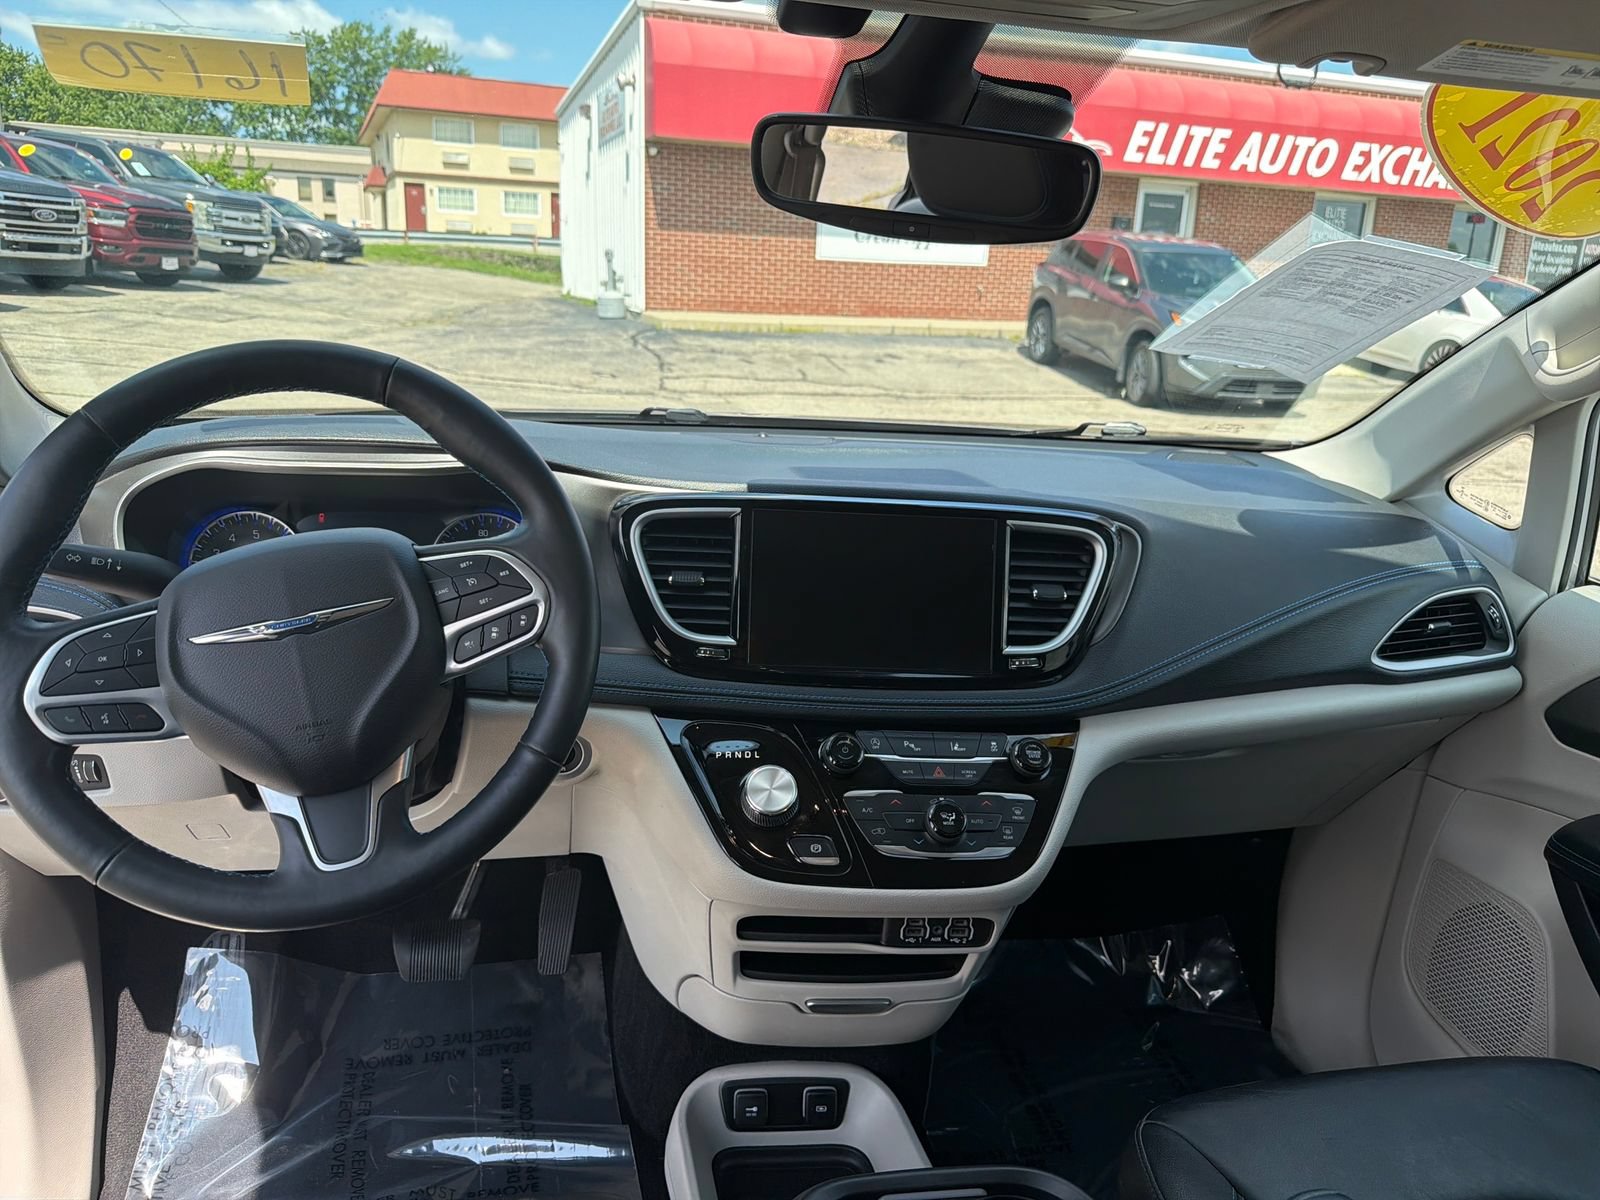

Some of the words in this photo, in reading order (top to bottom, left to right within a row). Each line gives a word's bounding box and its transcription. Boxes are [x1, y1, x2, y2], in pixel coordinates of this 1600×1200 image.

[1123, 120, 1232, 169] ELITE
[1230, 131, 1340, 179] AUTO
[1340, 142, 1456, 191] EXCHA
[229, 533, 237, 543] 4
[253, 529, 260, 539] 5
[478, 530, 489, 538] 80
[500, 569, 510, 577] RES
[97, 655, 108, 663] OK
[383, 1034, 436, 1051] COVER
